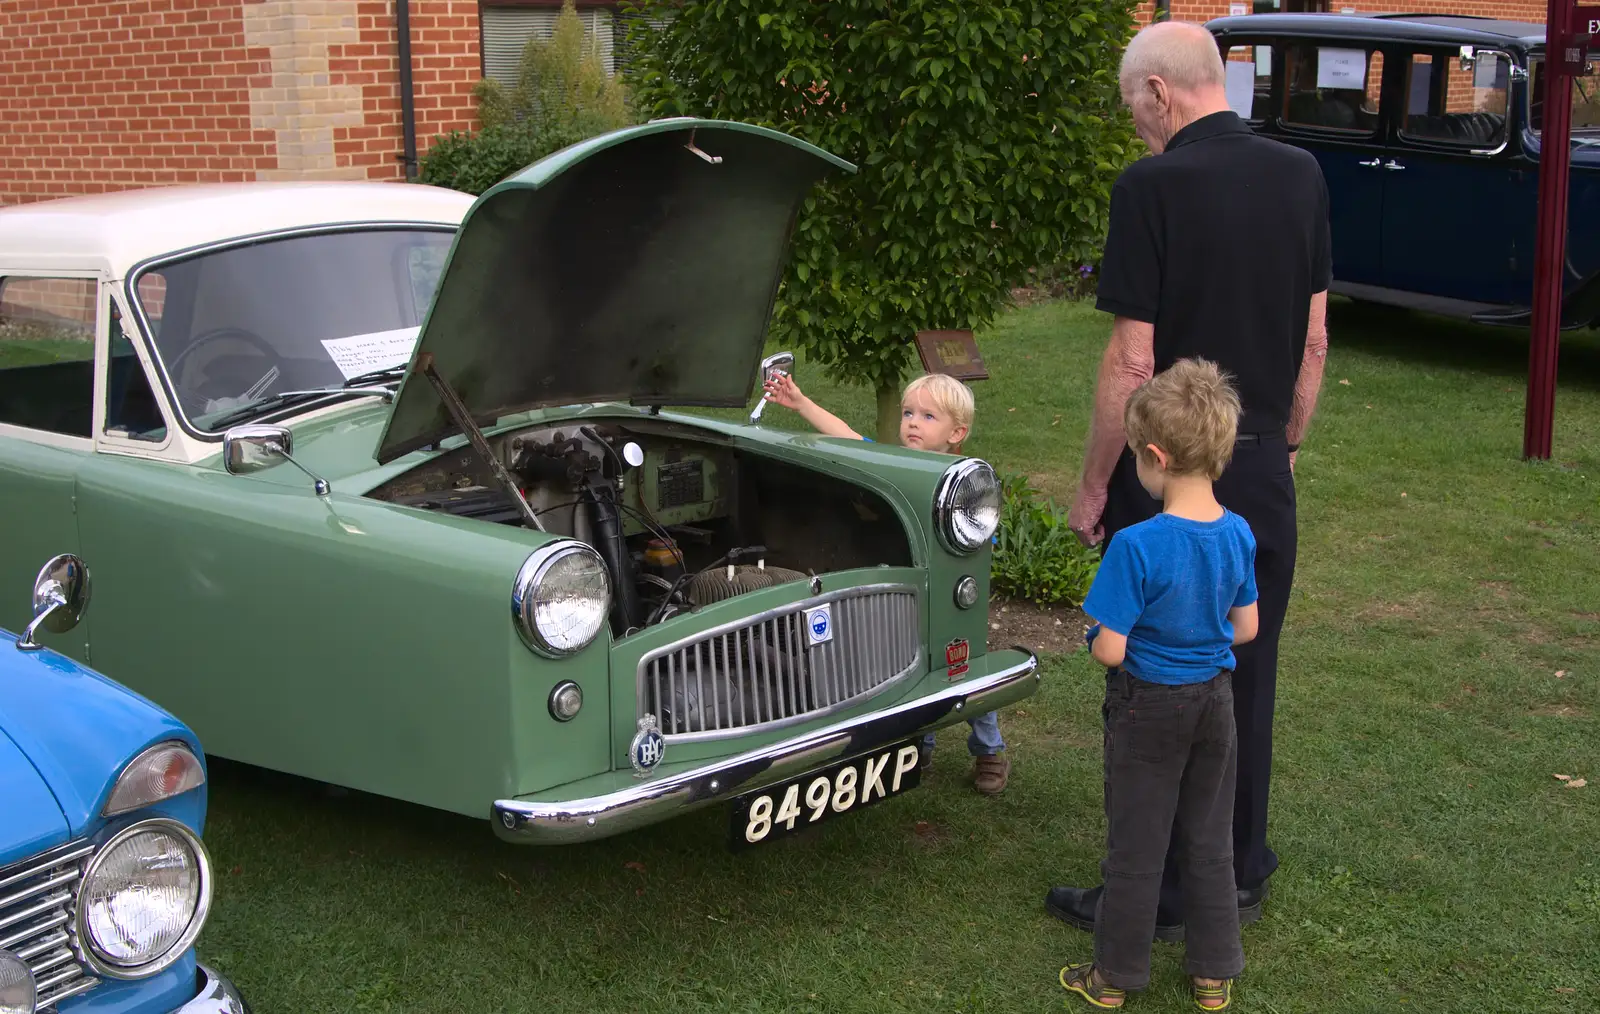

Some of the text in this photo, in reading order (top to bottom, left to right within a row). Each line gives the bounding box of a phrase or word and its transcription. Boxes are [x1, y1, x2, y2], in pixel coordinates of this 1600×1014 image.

[949, 645, 966, 662] BOND
[639, 735, 663, 766] RAC
[745, 745, 919, 843] 8498KP
